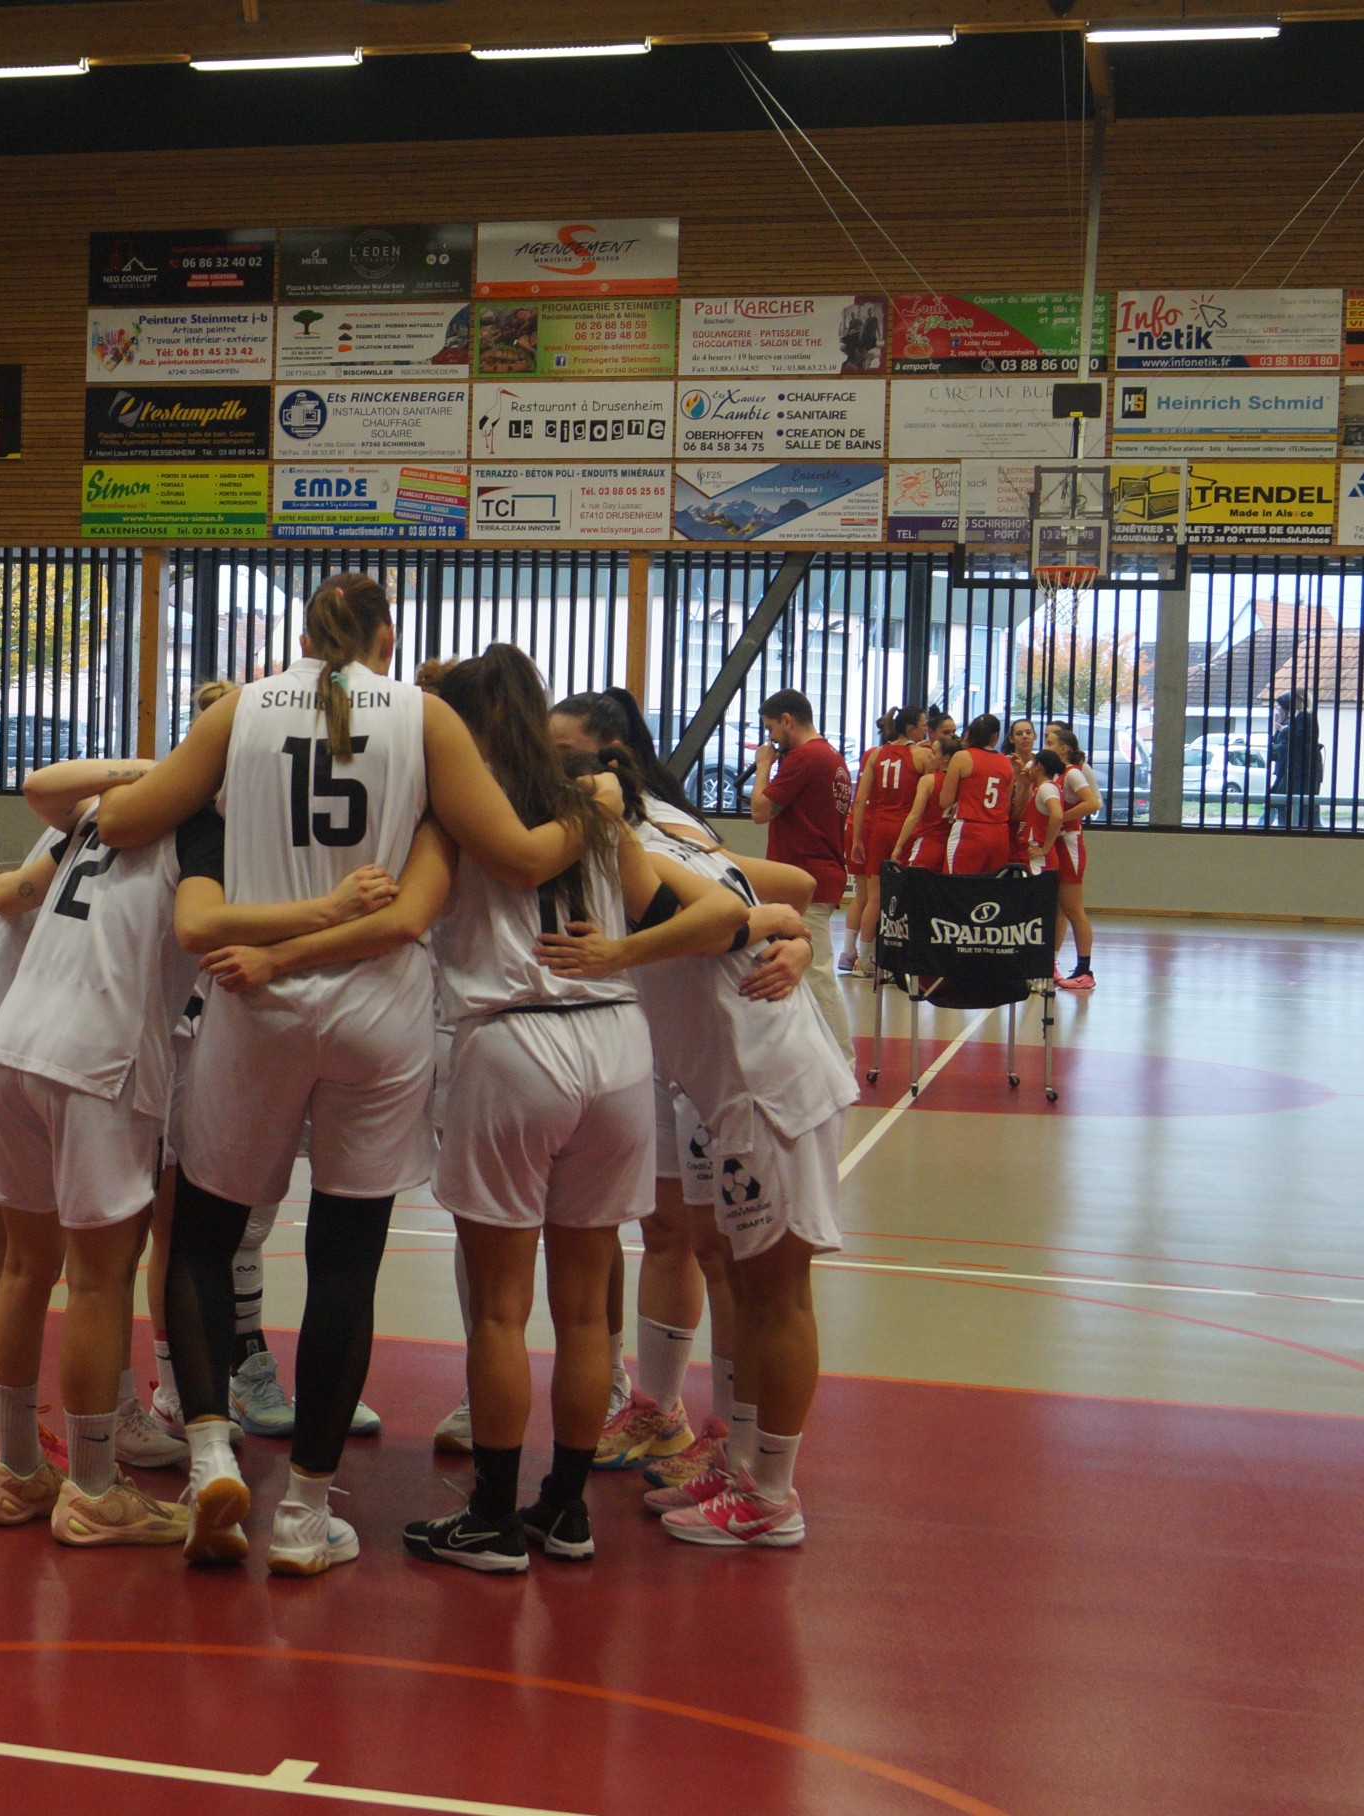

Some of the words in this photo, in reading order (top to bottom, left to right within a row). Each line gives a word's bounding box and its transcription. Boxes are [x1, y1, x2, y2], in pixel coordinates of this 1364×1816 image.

[515, 239, 640, 256] AGENCEMENT
[183, 258, 196, 267] 06
[199, 258, 212, 267] 86
[216, 258, 229, 267] 32
[232, 257, 245, 266] 40
[249, 257, 262, 266] 02
[542, 303, 610, 312] FROMAGERIE
[613, 302, 671, 310] STEINMETZ
[694, 302, 727, 315] Paul
[734, 299, 814, 316] KARCHER
[139, 315, 187, 325] Peinture
[191, 314, 248, 324] Steinmetz
[252, 313, 268, 325] j-b
[1117, 295, 1183, 338] Info
[206, 326, 236, 335] peintre
[693, 330, 752, 338] BOULANGERIE
[760, 329, 809, 337] PATISSERIE
[1127, 324, 1212, 350] -netik
[693, 340, 752, 348] CHOCOLATIER
[156, 348, 173, 357] Tél:
[1001, 360, 1016, 370] 03
[1021, 360, 1037, 370] 88
[1042, 360, 1057, 370] 86
[1061, 360, 1077, 370] 00
[1142, 357, 1230, 367] www.infonetik.fr
[1259, 356, 1272, 365] 03
[1274, 356, 1288, 365] 88
[1290, 356, 1309, 365] 180
[1313, 356, 1332, 365] 180
[902, 362, 941, 372] emporter
[327, 393, 346, 402] Ets
[351, 392, 465, 402] RINCKENBERGER
[787, 392, 856, 401] CHAUFFAGE
[511, 401, 576, 412] Restaurant
[581, 401, 587, 411] à
[592, 400, 663, 411] Drusenheim
[1157, 395, 1240, 410] Heinrich
[1247, 395, 1323, 410] Schmid
[140, 400, 247, 426] l'estampille
[332, 408, 399, 416] INSTALLATION
[403, 407, 452, 415] SANITAIRE
[711, 405, 770, 420] Lambic
[786, 410, 847, 420] SANITAIRE
[363, 419, 422, 427] CHAUFFAGE
[371, 430, 412, 438] SOLAIRE
[685, 431, 763, 440] OBERHOFFEN
[786, 429, 846, 438] CREATION
[850, 428, 865, 437] DE
[683, 443, 696, 451] 06
[700, 443, 713, 451] 84
[717, 443, 730, 451] 58
[734, 443, 747, 451] 34
[752, 443, 764, 451] 75
[785, 441, 821, 450] SALLE
[826, 440, 842, 449] DE
[846, 440, 882, 450] BAINS
[526, 468, 552, 477] BÉTON
[620, 468, 665, 476] MINÉRAUX
[86, 470, 150, 502] Simon
[294, 478, 367, 497] EMDE
[580, 487, 595, 495] Tél.
[782, 485, 804, 494] grand
[1194, 486, 1332, 503] TRENDEL
[482, 499, 515, 516] TCI
[602, 502, 615, 510] Gay
[1229, 509, 1258, 517] Made
[1262, 509, 1271, 517] in
[278, 526, 294, 535] 67770
[296, 526, 334, 535] STATTMATTEN
[579, 526, 662, 535] www.tcisynergie.com
[880, 759, 901, 789] 11
[282, 736, 369, 847] 15
[984, 777, 999, 809] 5
[931, 917, 1045, 945] SPALDING
[736, 1218, 764, 1231] CRAFT
